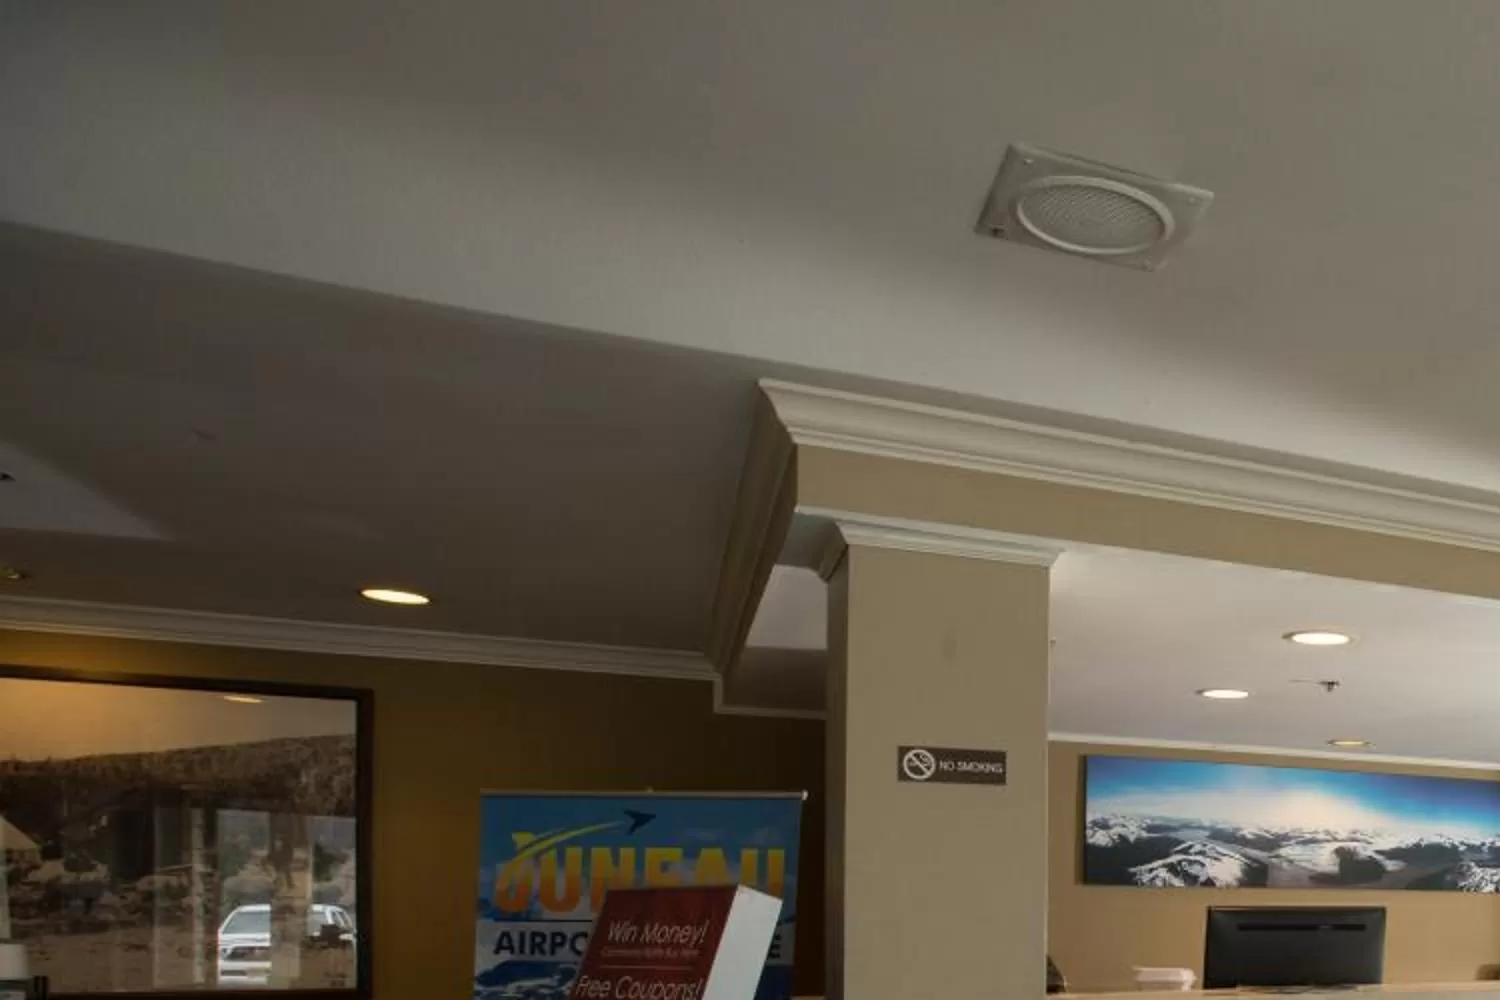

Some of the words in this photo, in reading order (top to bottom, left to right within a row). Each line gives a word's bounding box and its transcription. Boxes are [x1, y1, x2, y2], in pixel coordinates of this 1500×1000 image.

[940, 760, 954, 771] NO
[957, 760, 1003, 773] SMOKING
[608, 919, 638, 944] Win
[639, 919, 710, 948] Money!
[575, 975, 612, 998] Free
